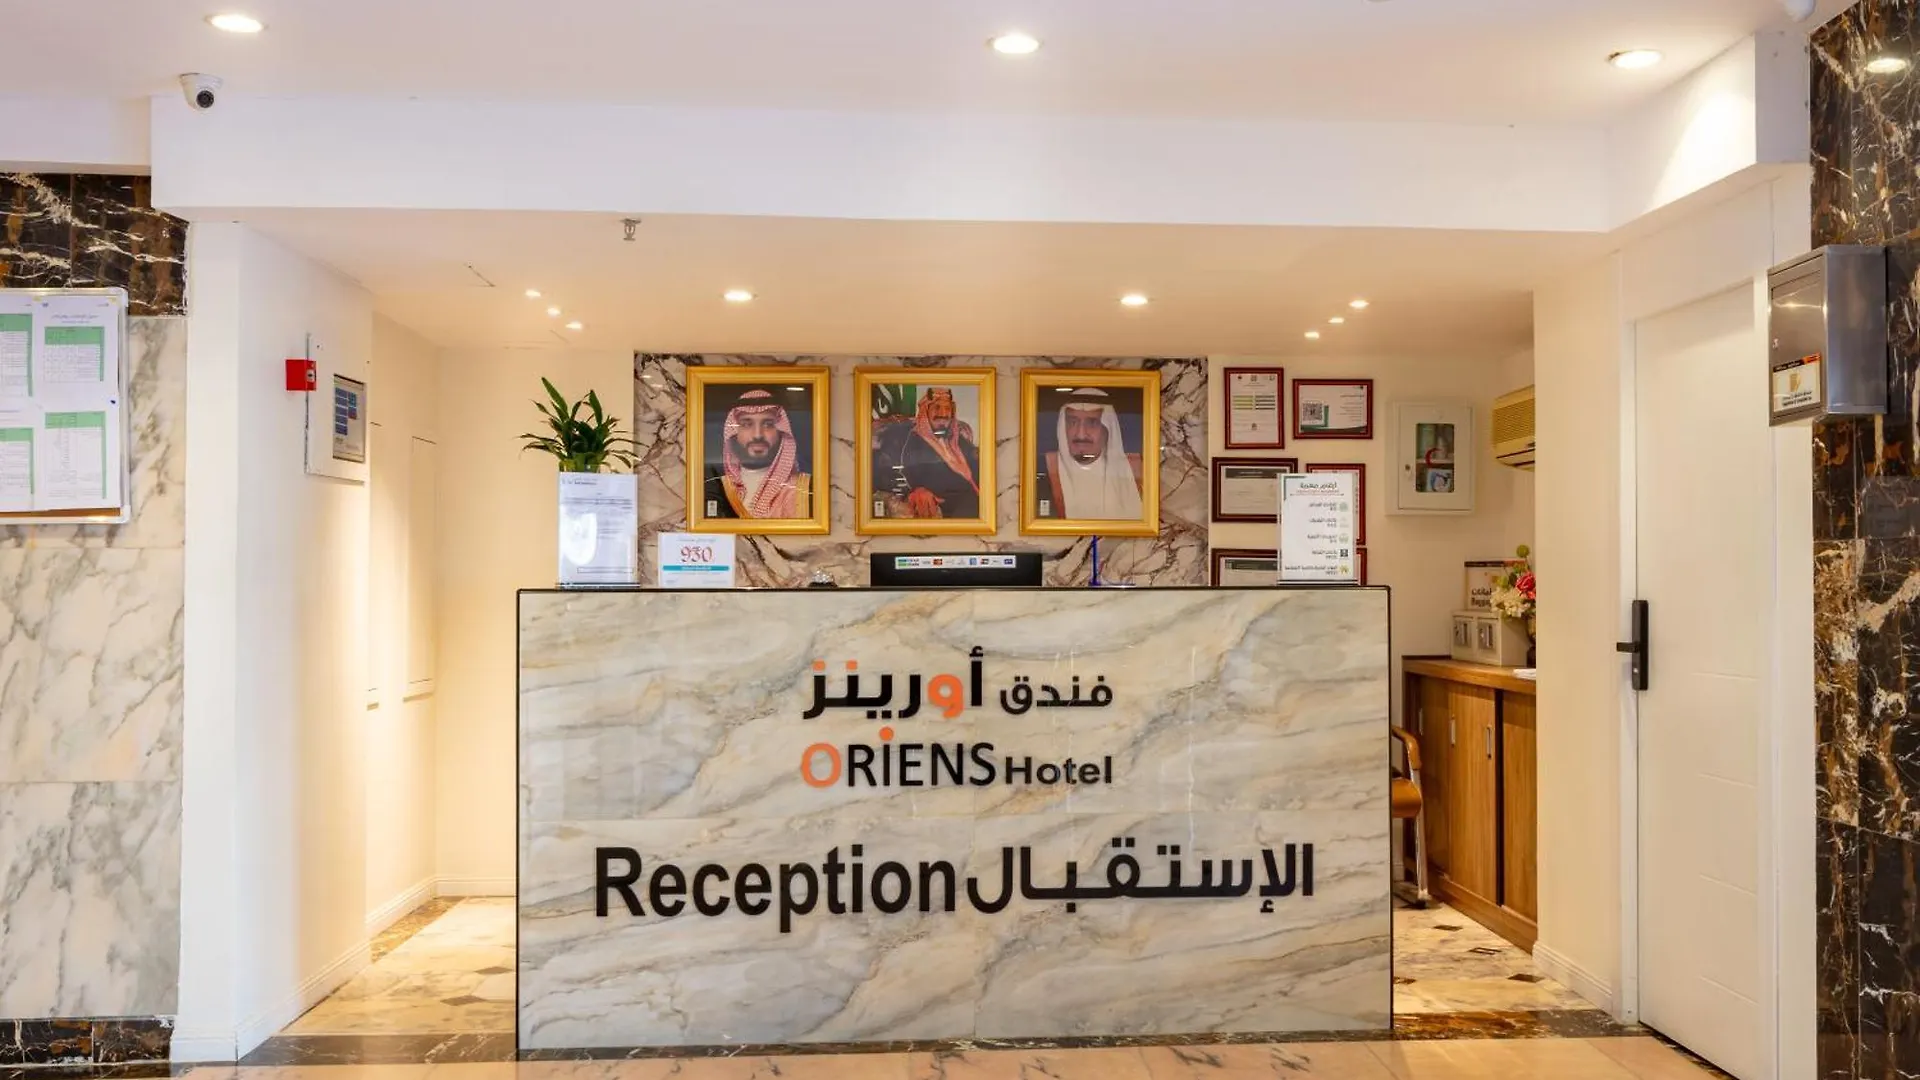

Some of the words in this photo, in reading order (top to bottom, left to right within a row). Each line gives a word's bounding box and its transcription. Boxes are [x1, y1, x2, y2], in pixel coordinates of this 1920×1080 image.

[680, 545, 713, 562] 930
[802, 645, 984, 720] أورينز
[999, 675, 1113, 716] فندق
[1004, 755, 1112, 785] Hotel
[595, 843, 956, 934] Reception
[966, 837, 1315, 914] الإستقبال
